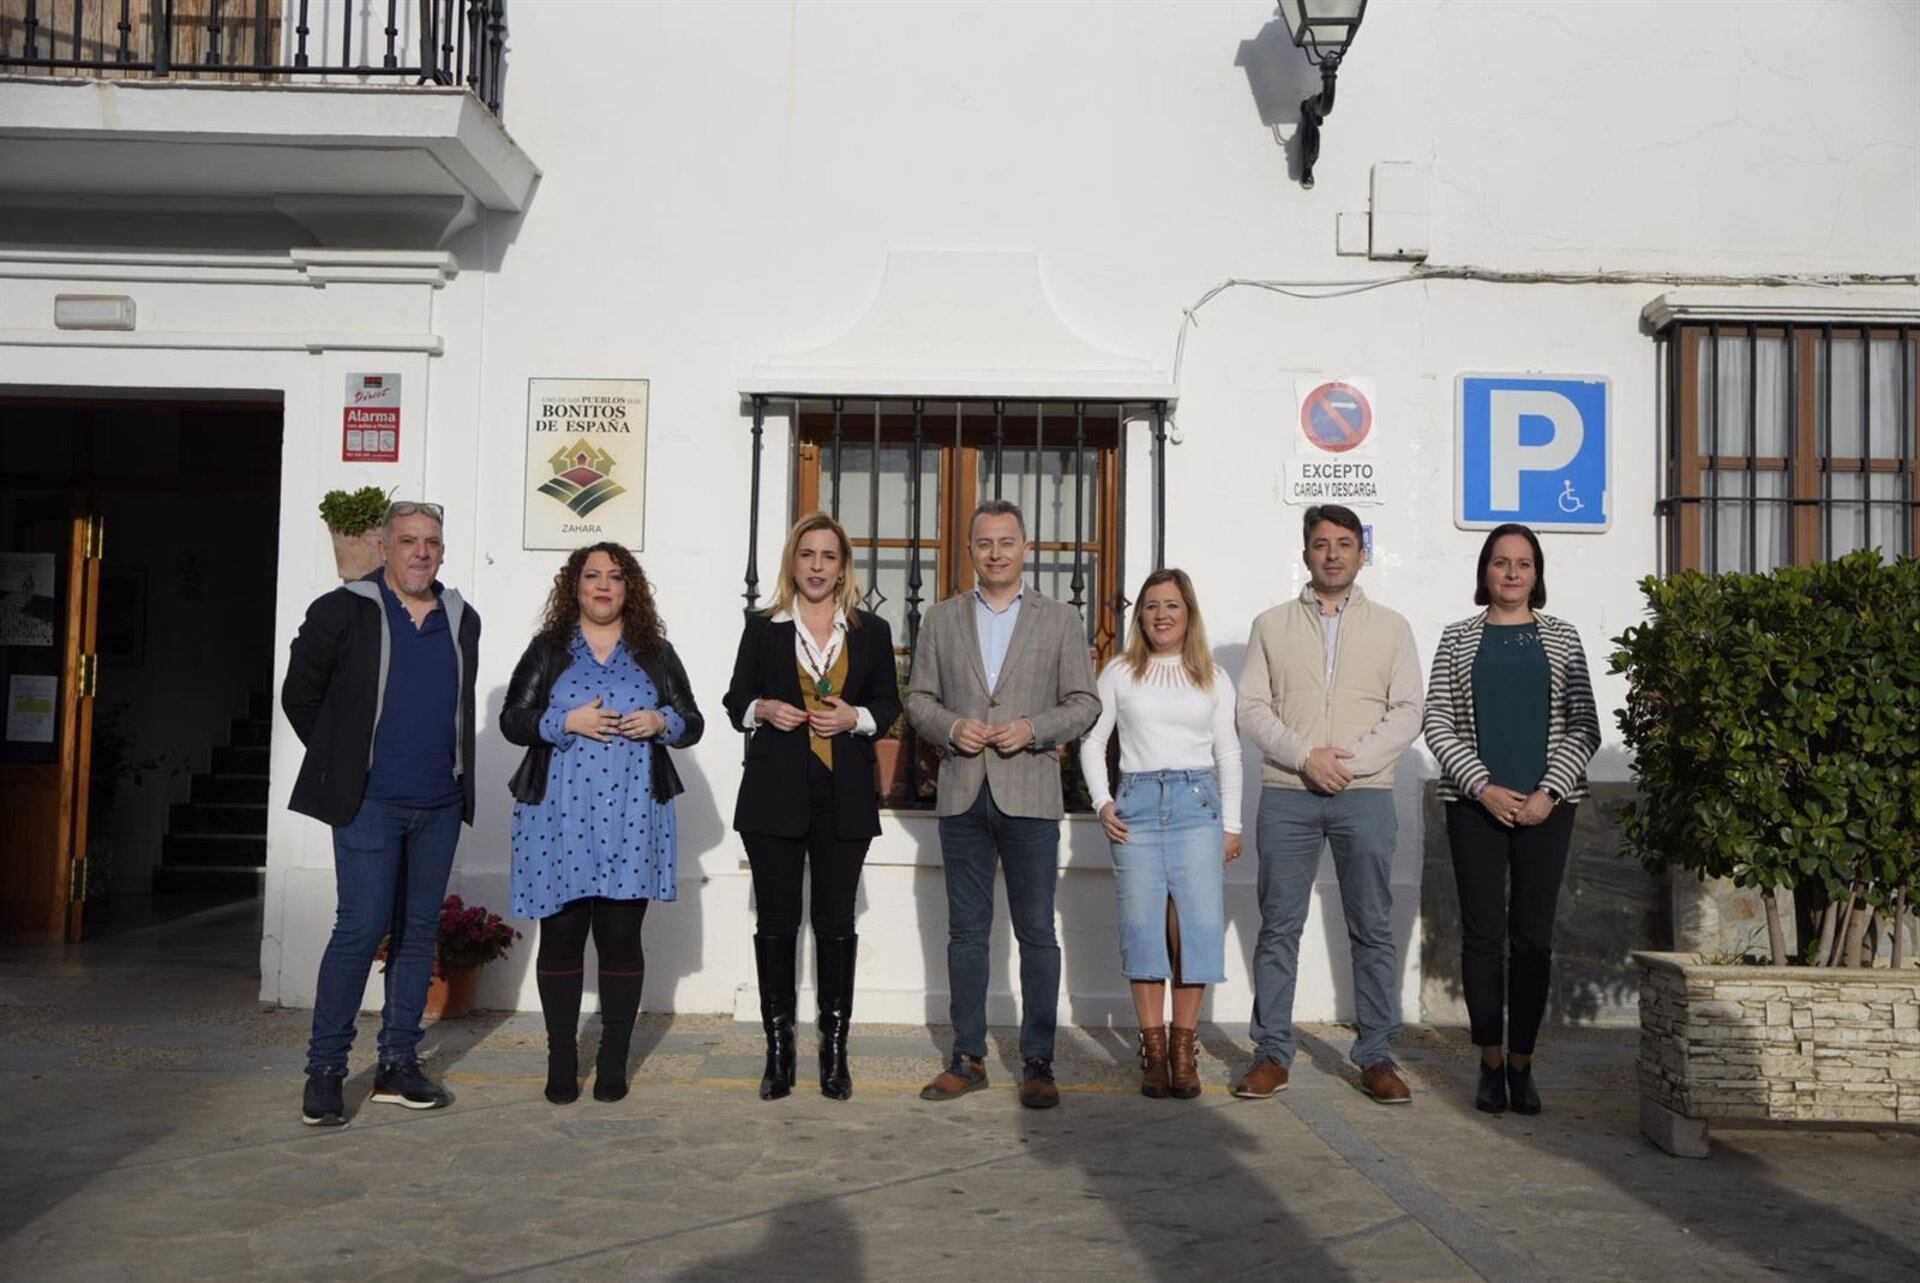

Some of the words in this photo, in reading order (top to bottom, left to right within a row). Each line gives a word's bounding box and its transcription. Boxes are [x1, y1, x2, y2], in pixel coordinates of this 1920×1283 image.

[582, 396, 626, 404] PUEBLOS
[348, 410, 396, 422] Alarma
[542, 404, 626, 419] BONITOS
[535, 420, 558, 432] DE
[566, 418, 631, 433] ESPAÑA
[1489, 388, 1585, 512] P
[1302, 463, 1373, 479] EXCEPTO
[1295, 482, 1322, 497] CARGA
[1323, 483, 1330, 497] Y
[1332, 482, 1377, 497] DESCARGA
[561, 524, 602, 533] ZAHARA
